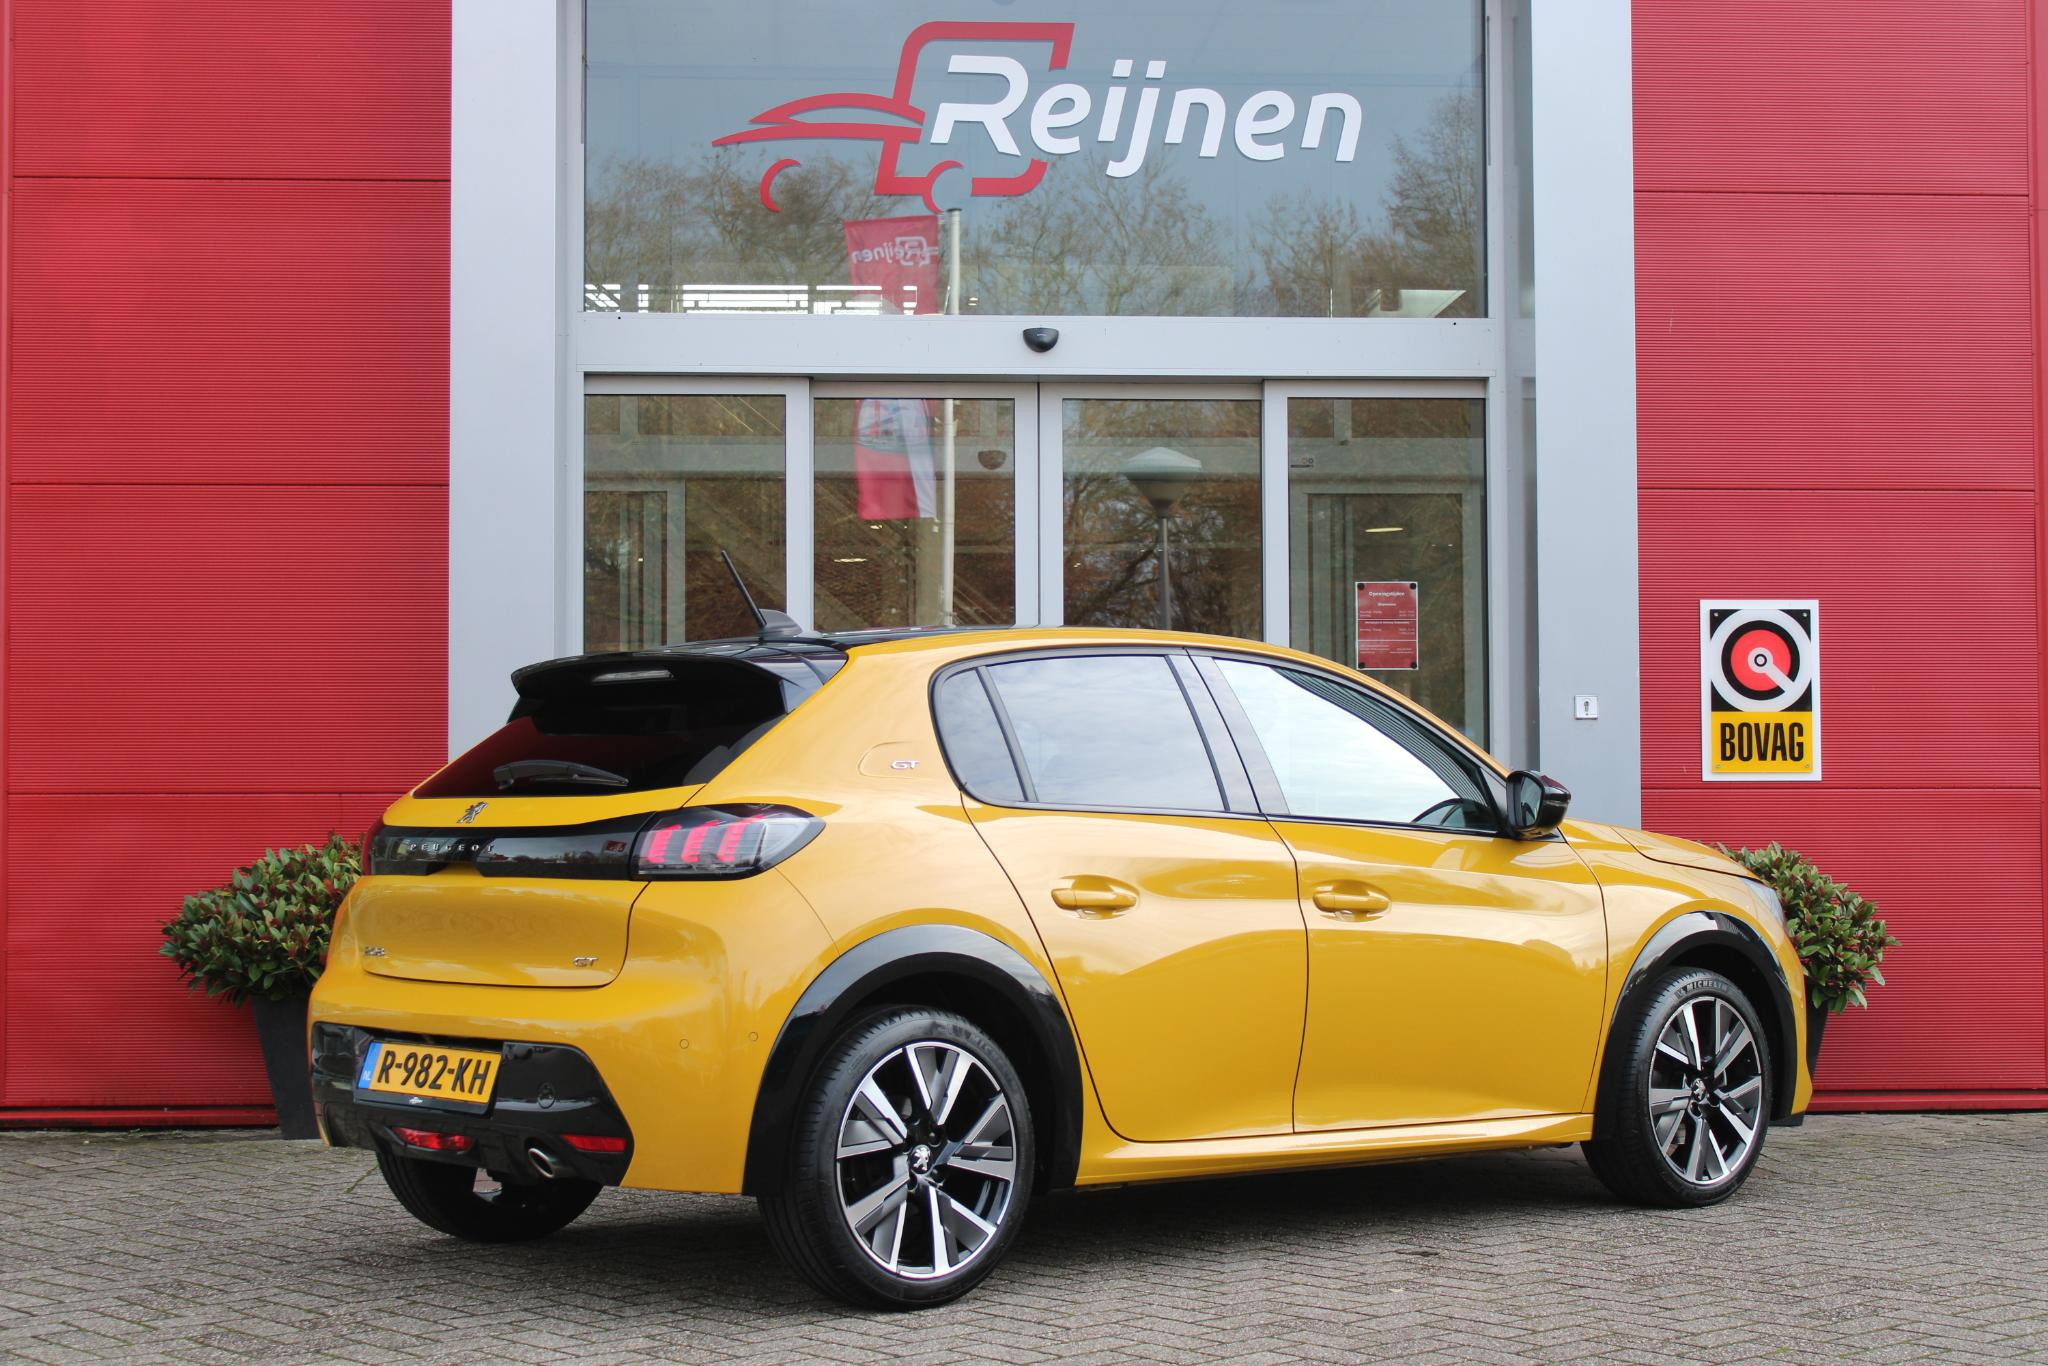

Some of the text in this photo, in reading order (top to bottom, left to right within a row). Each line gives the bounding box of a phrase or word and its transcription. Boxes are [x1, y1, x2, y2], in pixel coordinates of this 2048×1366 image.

[930, 54, 1363, 178] Reijnen
[1720, 722, 1804, 761] BOVAG
[891, 760, 919, 769] GT
[409, 843, 494, 853] PEUGEOT
[573, 957, 598, 967] GT
[1686, 980, 1728, 993] MICHELIN
[362, 1070, 371, 1081] NL
[377, 1050, 491, 1095] R-982-KH
